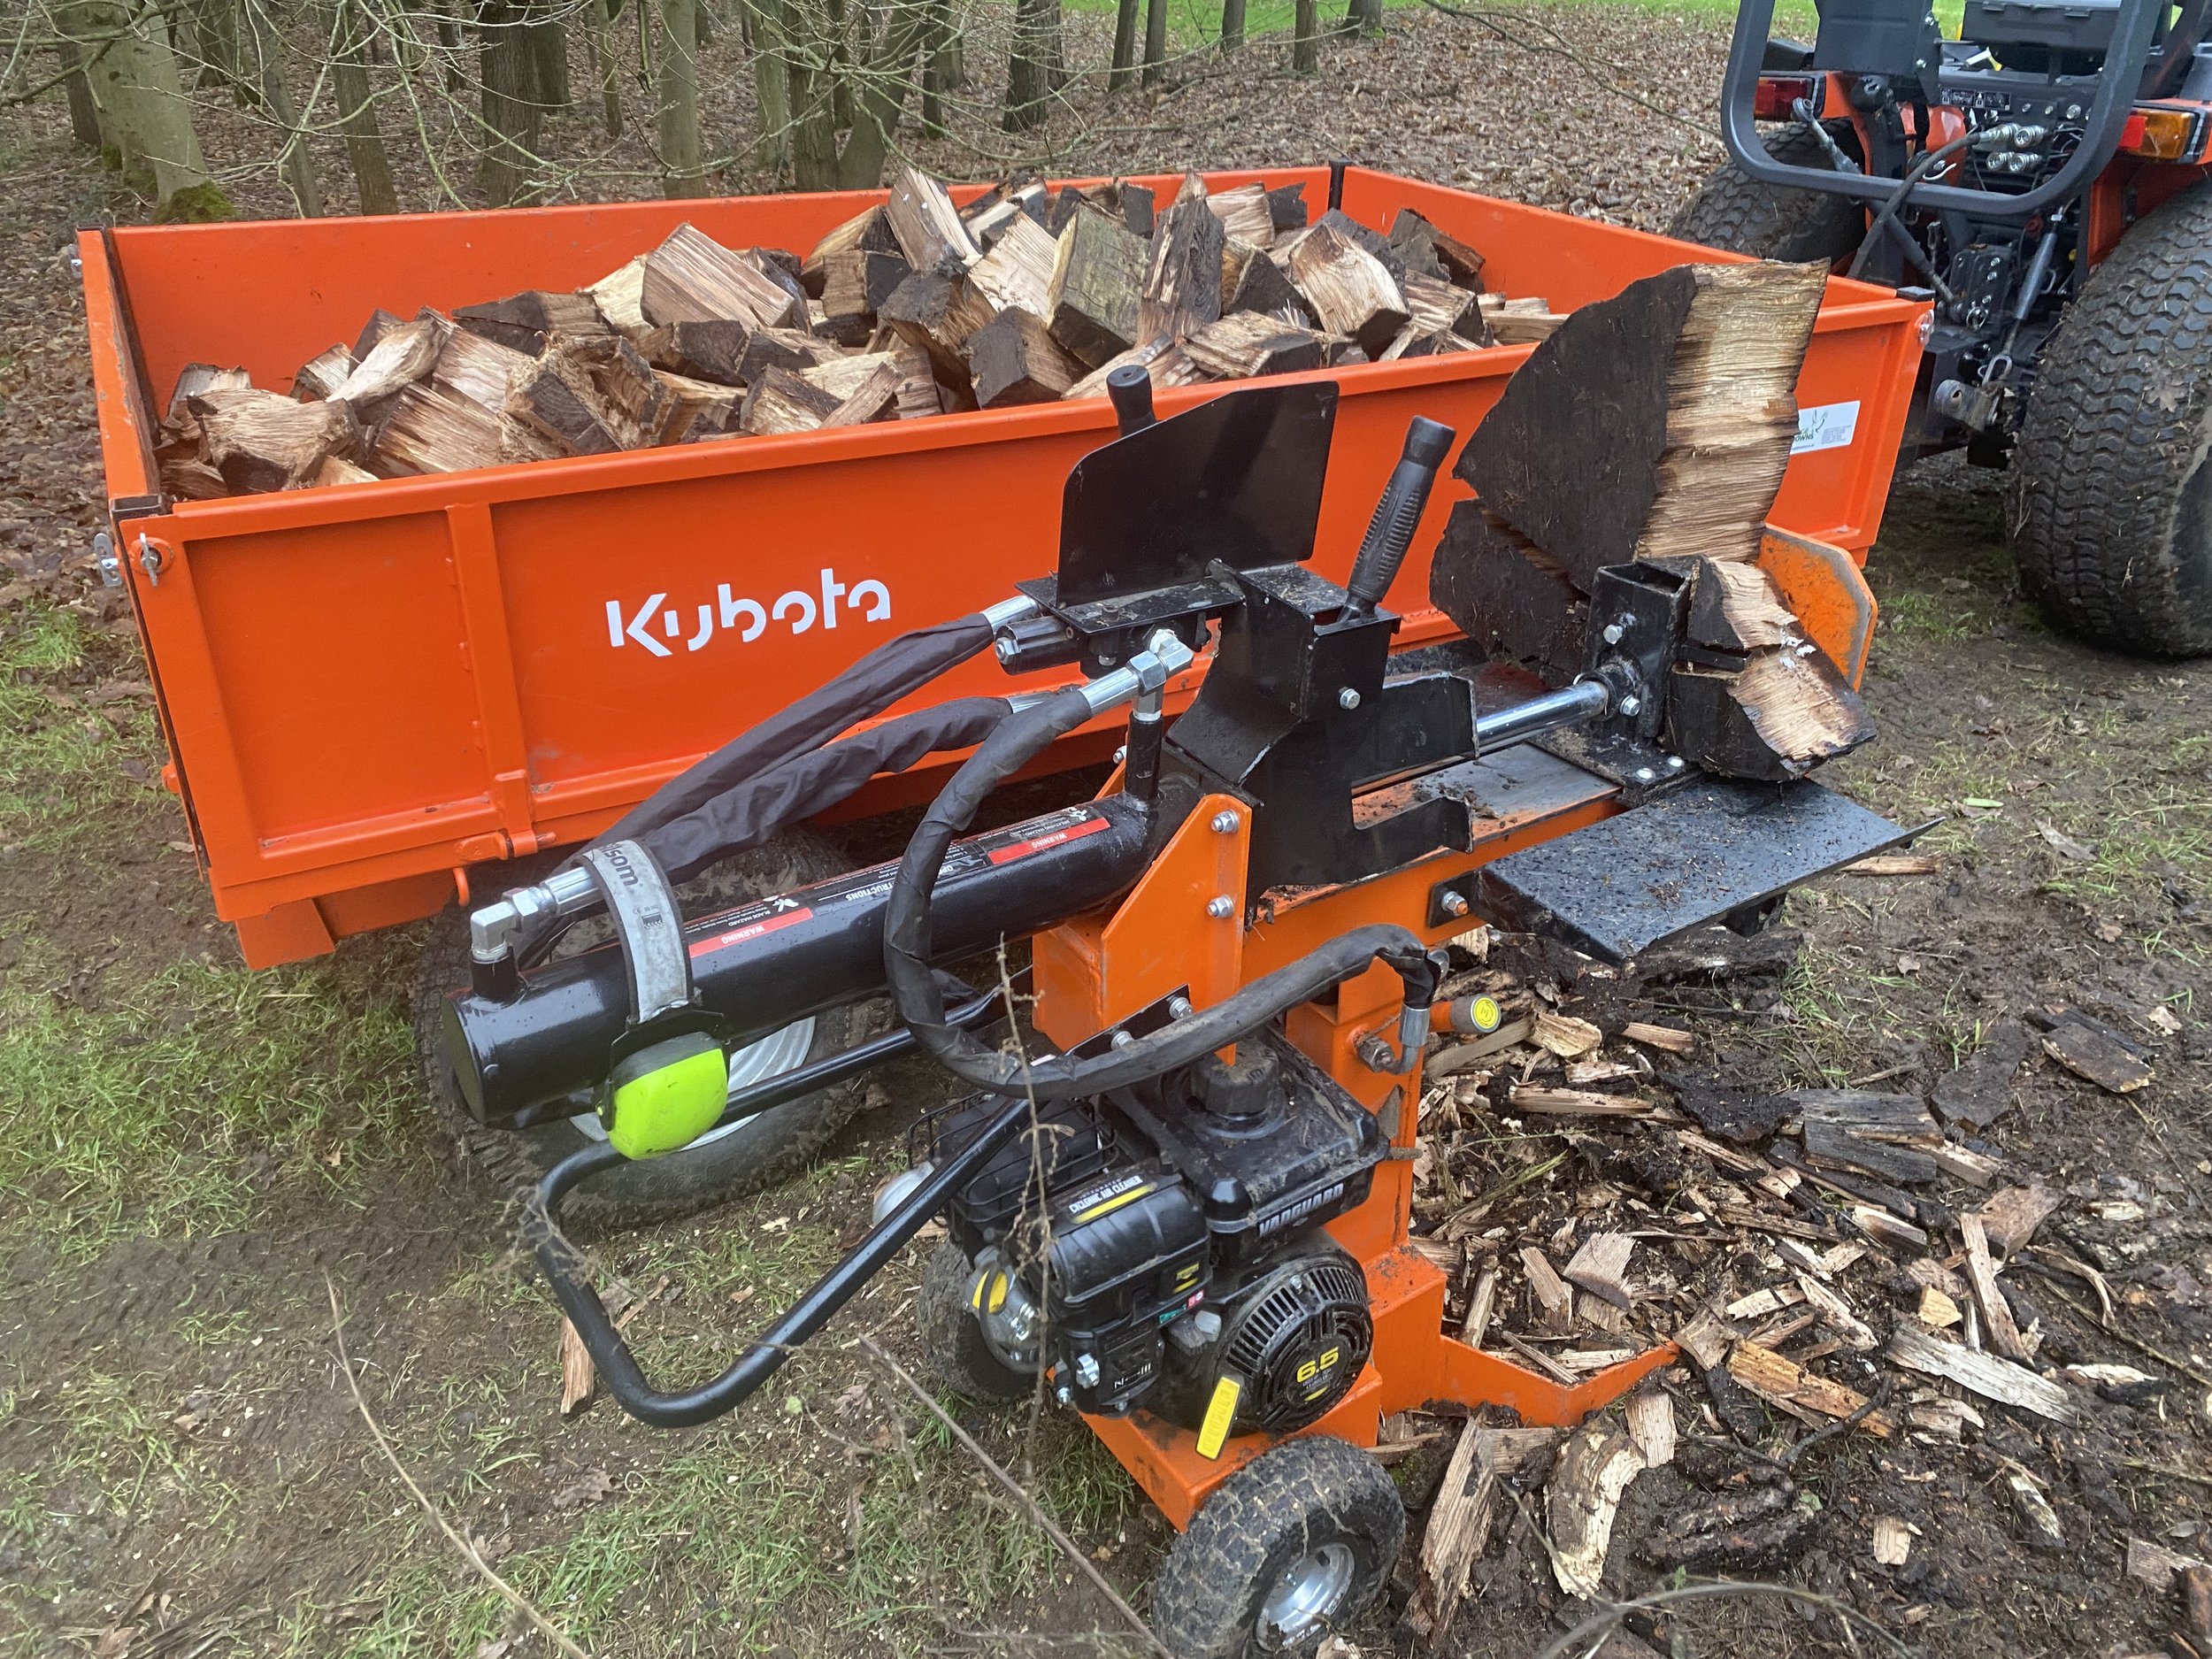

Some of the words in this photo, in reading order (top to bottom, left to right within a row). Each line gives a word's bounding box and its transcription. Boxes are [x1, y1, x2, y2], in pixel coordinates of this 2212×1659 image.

[605, 568, 890, 657] Kubota
[1031, 832, 1068, 849] WARNING
[844, 881, 894, 902] TRUCTIONS
[720, 925, 765, 945] WARNING
[1068, 1193, 1102, 1214] CYCLONIC
[1100, 1187, 1115, 1200] AIR
[1111, 1175, 1143, 1194] CLEANER
[1259, 1182, 1344, 1238] VANGUARD
[1296, 1346, 1339, 1383] 6.5
